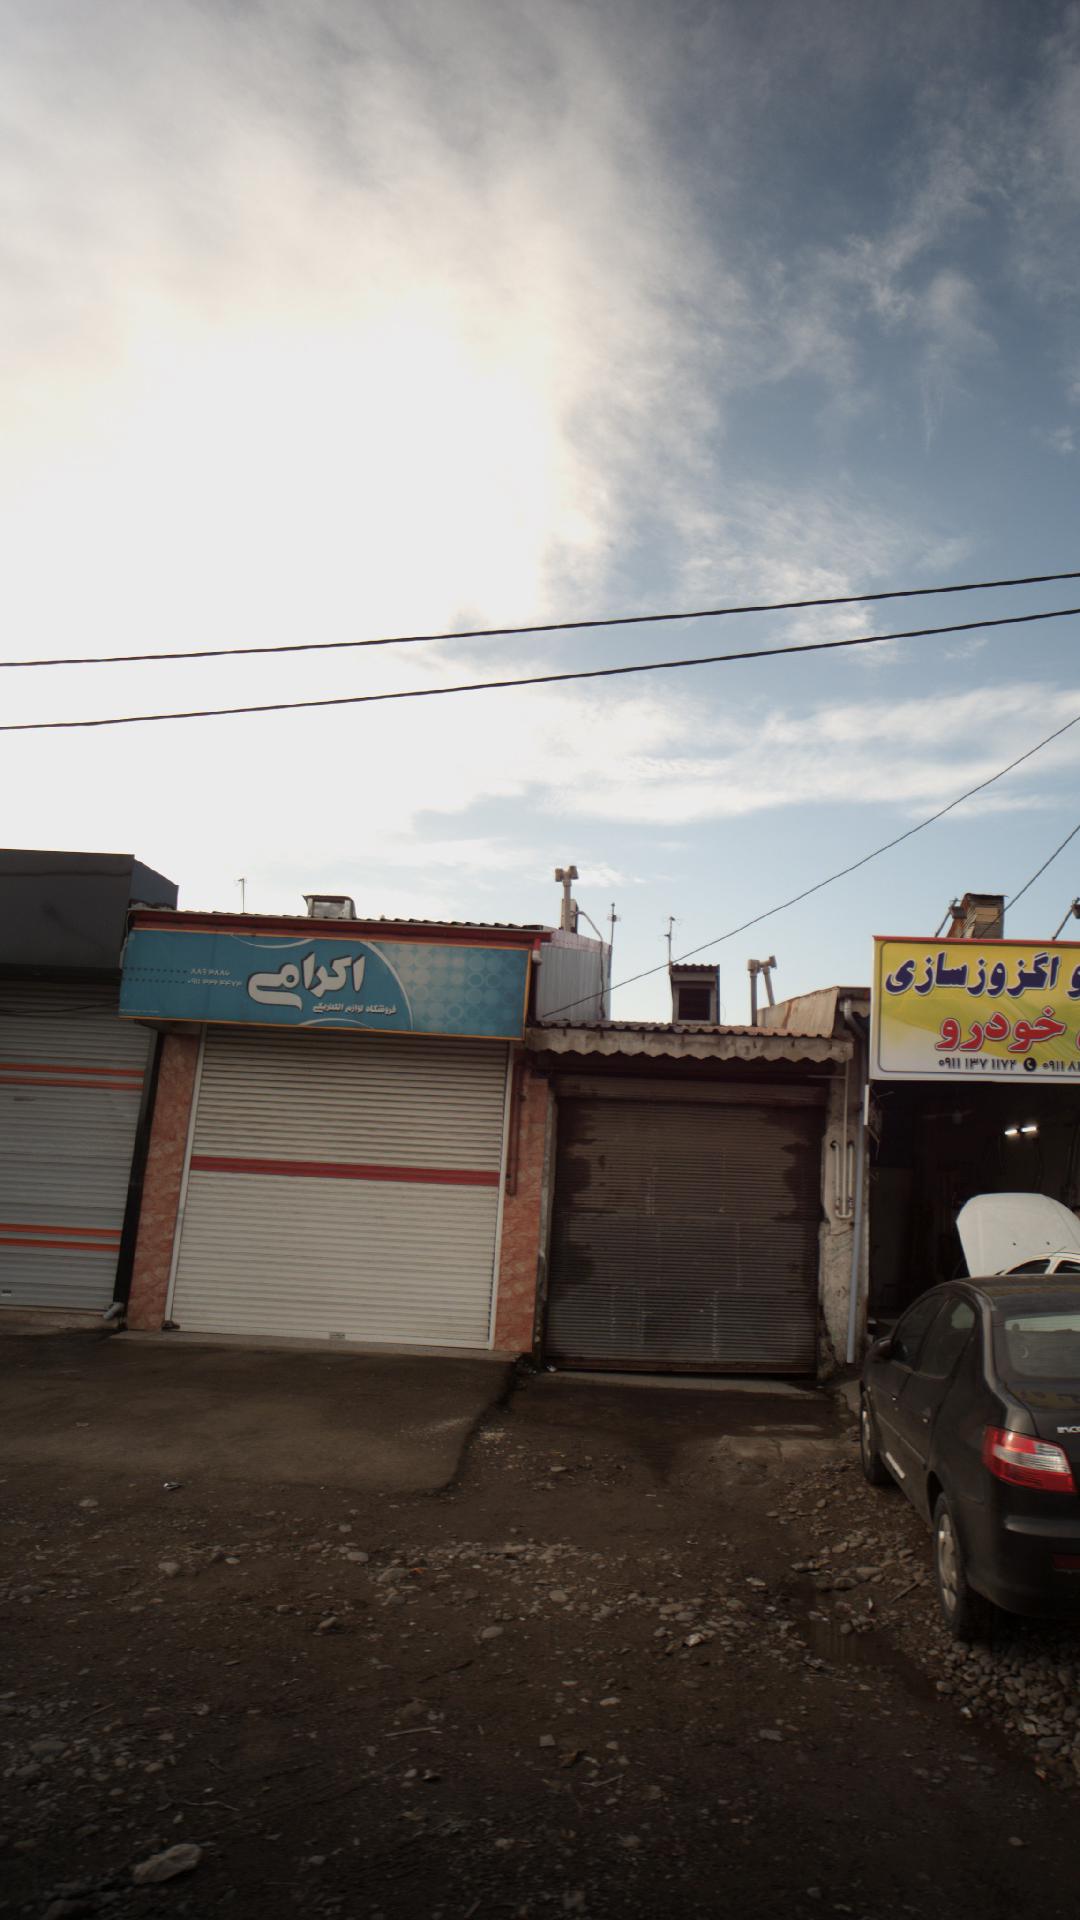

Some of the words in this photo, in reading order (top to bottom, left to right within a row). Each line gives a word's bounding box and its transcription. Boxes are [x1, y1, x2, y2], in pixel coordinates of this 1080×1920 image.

[247, 952, 365, 1010] اکرامی
[345, 1003, 363, 1013] لوازم
[365, 1003, 397, 1015] فروشگاه
[935, 1005, 1066, 1053] خودرو
[939, 1057, 961, 1070] ۰۹۱۱
[1043, 1060, 1065, 1072] ۰۹۱۱
